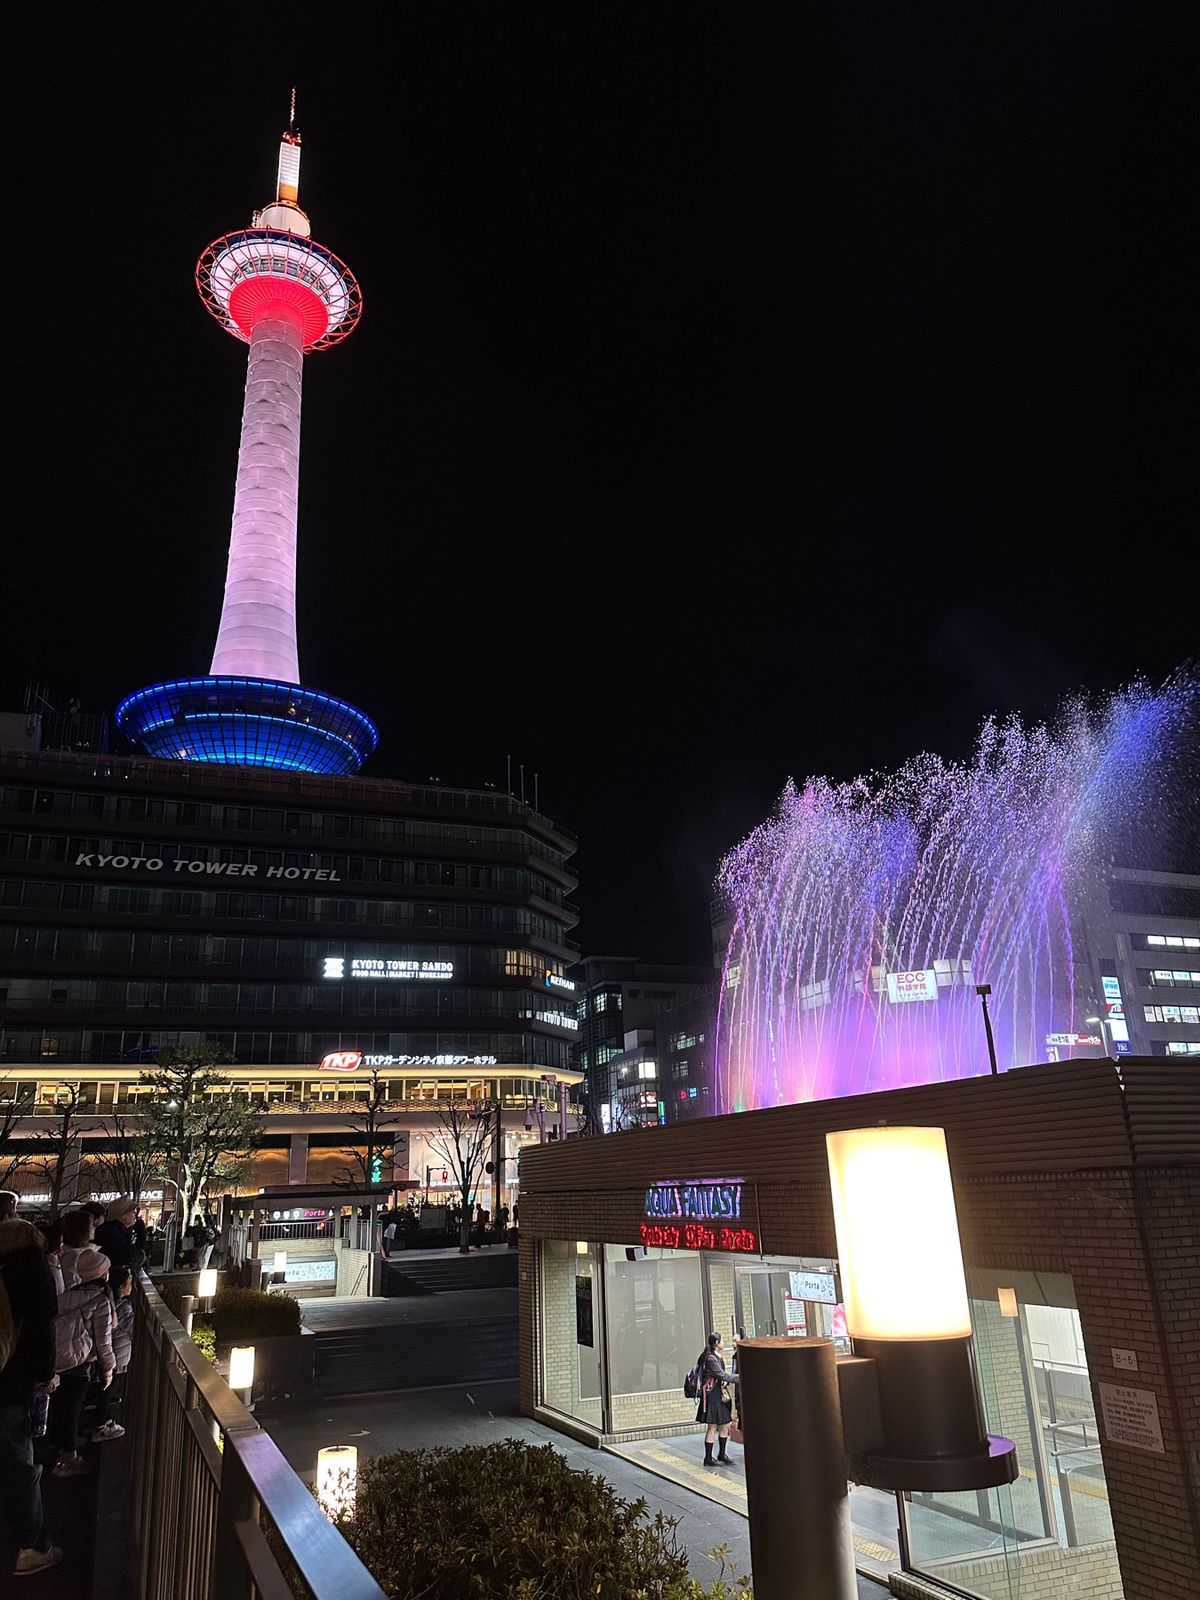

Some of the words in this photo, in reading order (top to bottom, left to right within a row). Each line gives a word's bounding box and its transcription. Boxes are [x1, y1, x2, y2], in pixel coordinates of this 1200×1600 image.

[75, 853, 164, 871] KYOTO
[173, 859, 258, 877] TOWER
[266, 865, 342, 882] HOTEL
[352, 959, 384, 970] KYOTO
[386, 960, 419, 971] TOWER
[421, 961, 454, 972] SANDO
[369, 970, 386, 978] HALL
[389, 971, 415, 979] MARKET
[896, 972, 926, 984] ECC
[550, 975, 575, 991] KEIHAN
[322, 1053, 356, 1067] TKP
[364, 1055, 498, 1066] TKPガーデンシティ京都タワーホテル
[645, 1187, 682, 1218] AQUA
[682, 1185, 741, 1219] FANTASY
[304, 1209, 326, 1217] Porta
[804, 1281, 820, 1290] Porta
[1116, 1354, 1133, 1365] B-5
